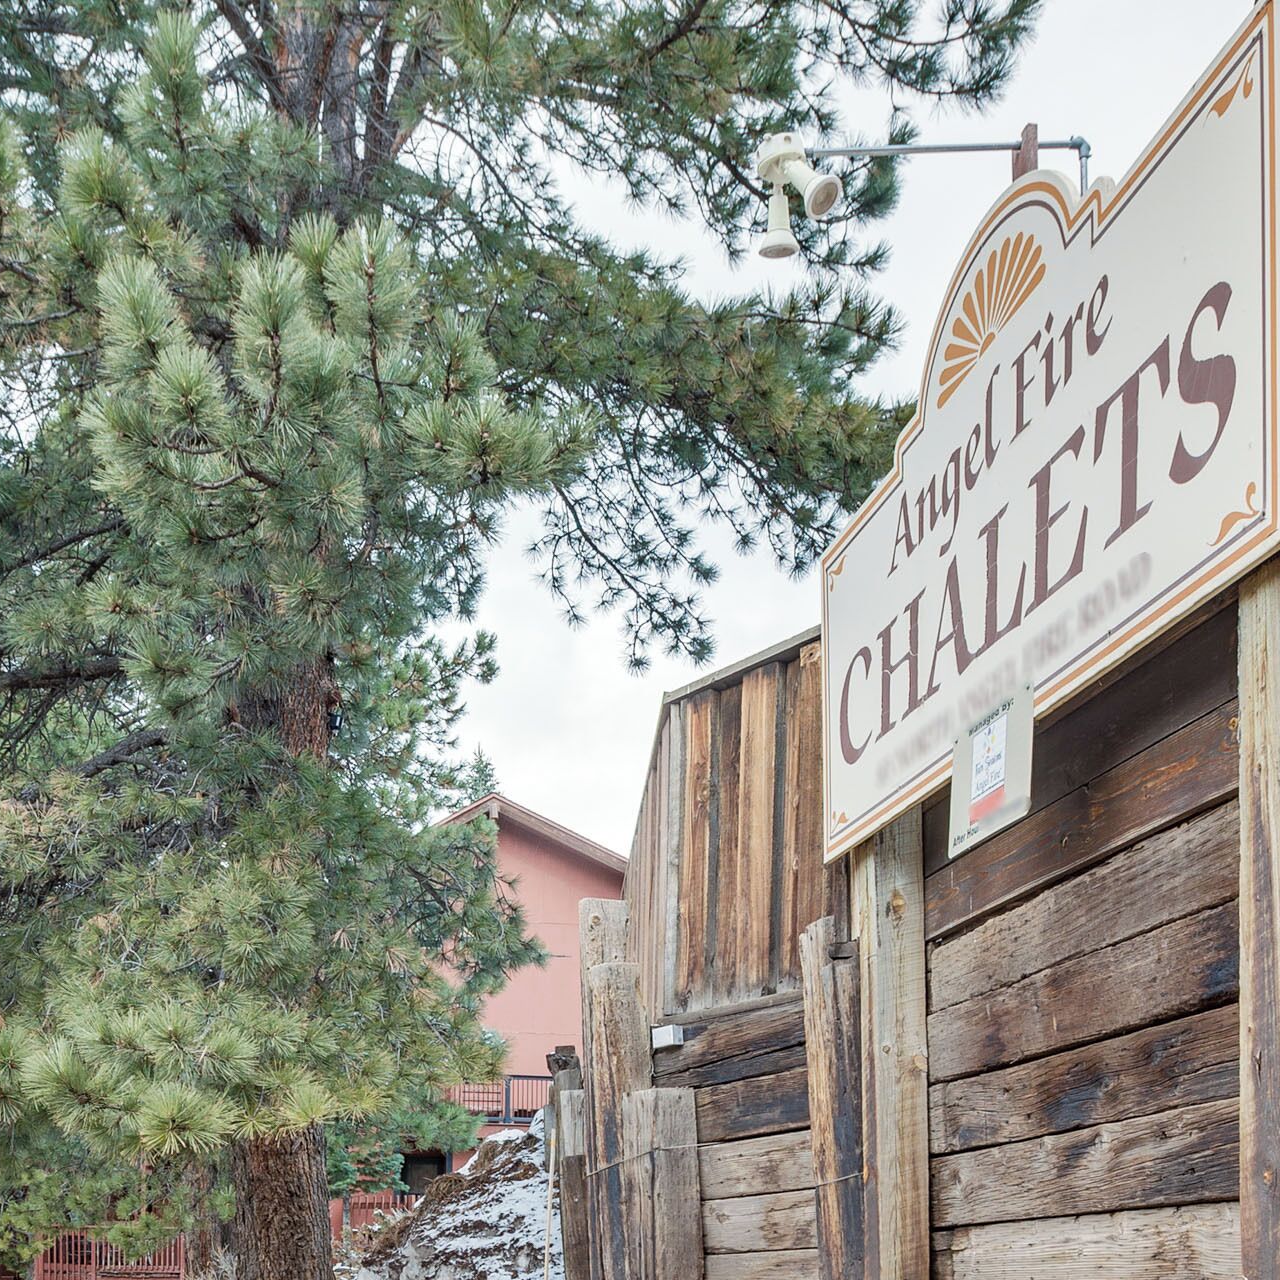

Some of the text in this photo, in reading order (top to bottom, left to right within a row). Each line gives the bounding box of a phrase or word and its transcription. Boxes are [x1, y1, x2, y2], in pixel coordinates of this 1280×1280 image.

[839, 280, 1238, 766] CHALETS
[887, 273, 1114, 578] Angel Fire
